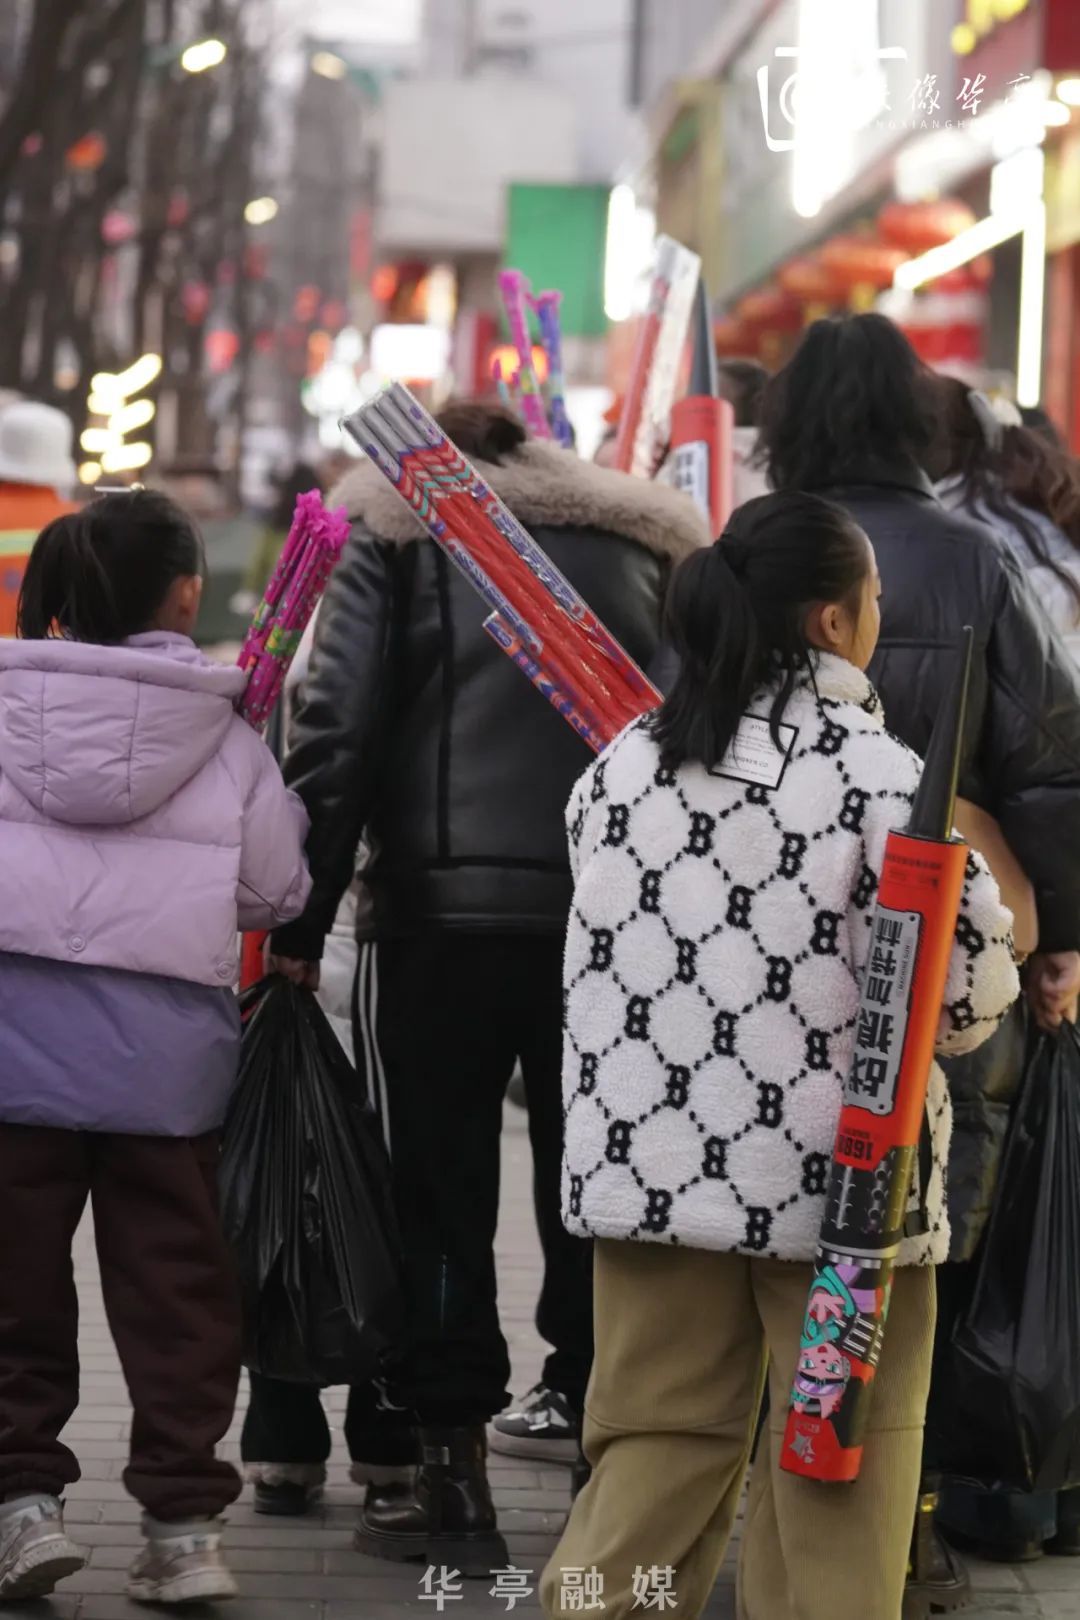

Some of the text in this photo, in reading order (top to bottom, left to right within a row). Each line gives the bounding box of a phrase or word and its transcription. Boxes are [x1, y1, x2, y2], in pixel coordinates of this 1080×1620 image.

[849, 916, 903, 1098] 战狼加特林
